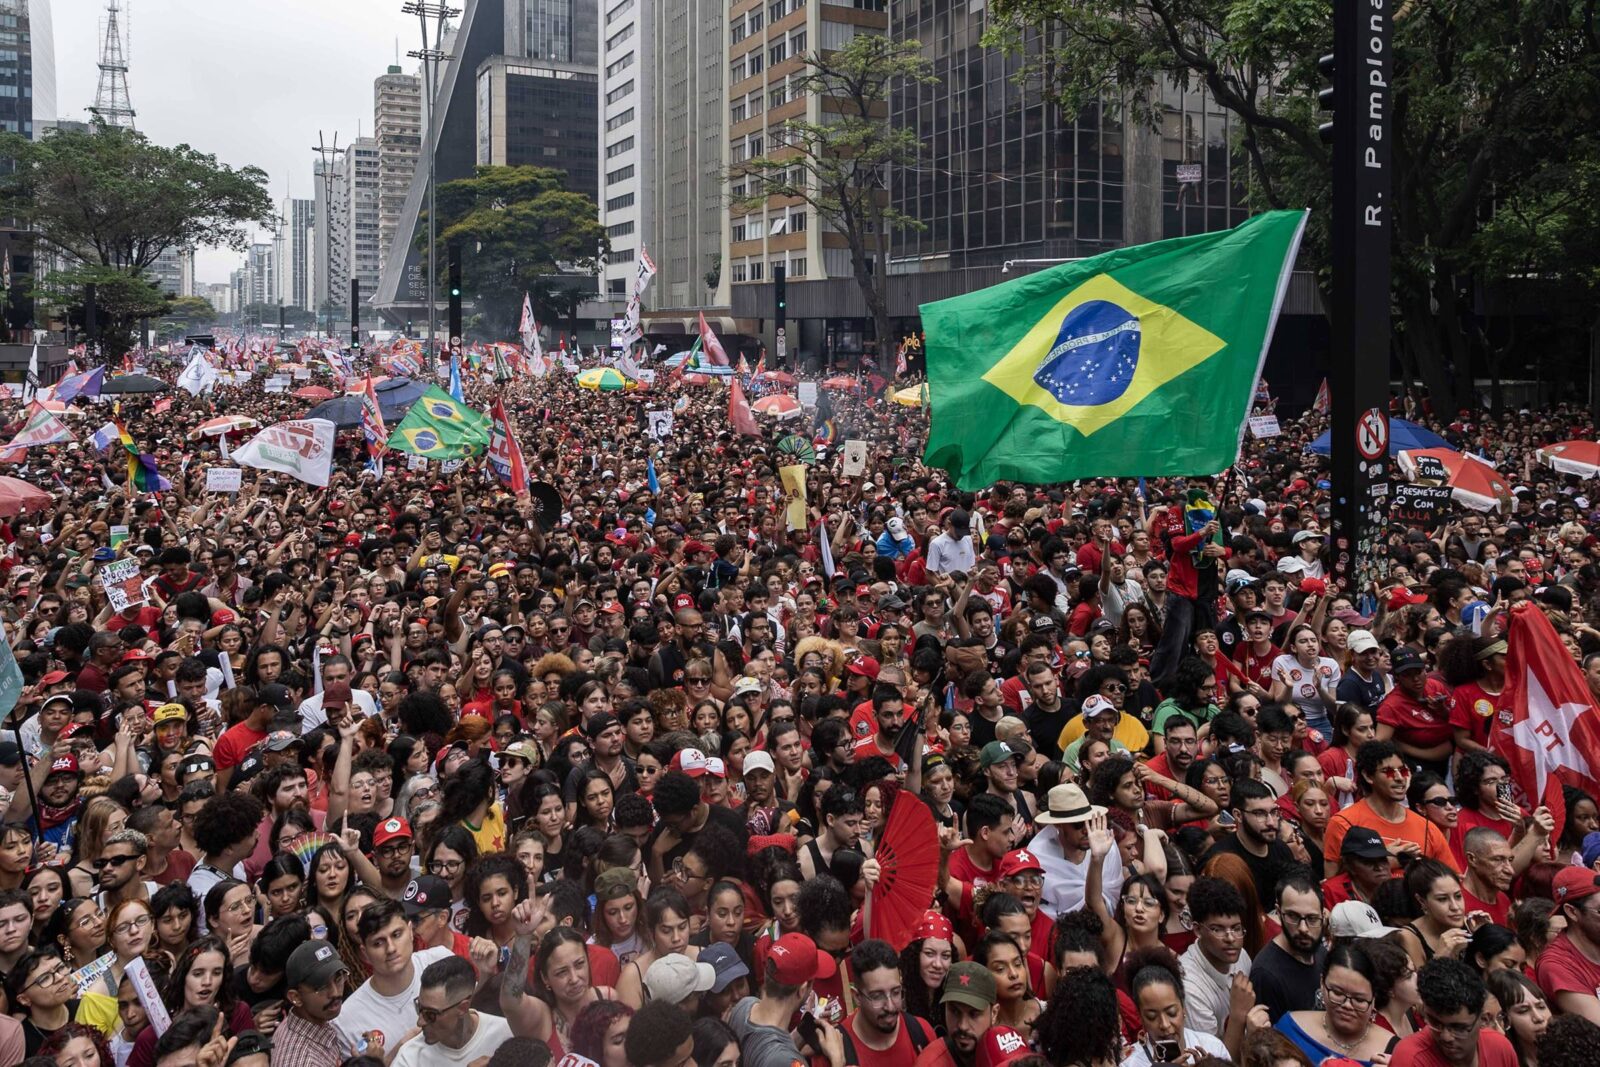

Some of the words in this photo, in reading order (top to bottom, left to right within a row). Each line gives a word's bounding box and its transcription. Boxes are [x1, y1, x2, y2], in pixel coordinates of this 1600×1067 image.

[1365, 0, 1387, 168] Pamplona
[1365, 192, 1382, 226] R.
[1399, 508, 1430, 520] LULA
[1414, 499, 1434, 508] COM
[1535, 720, 1564, 752] PT
